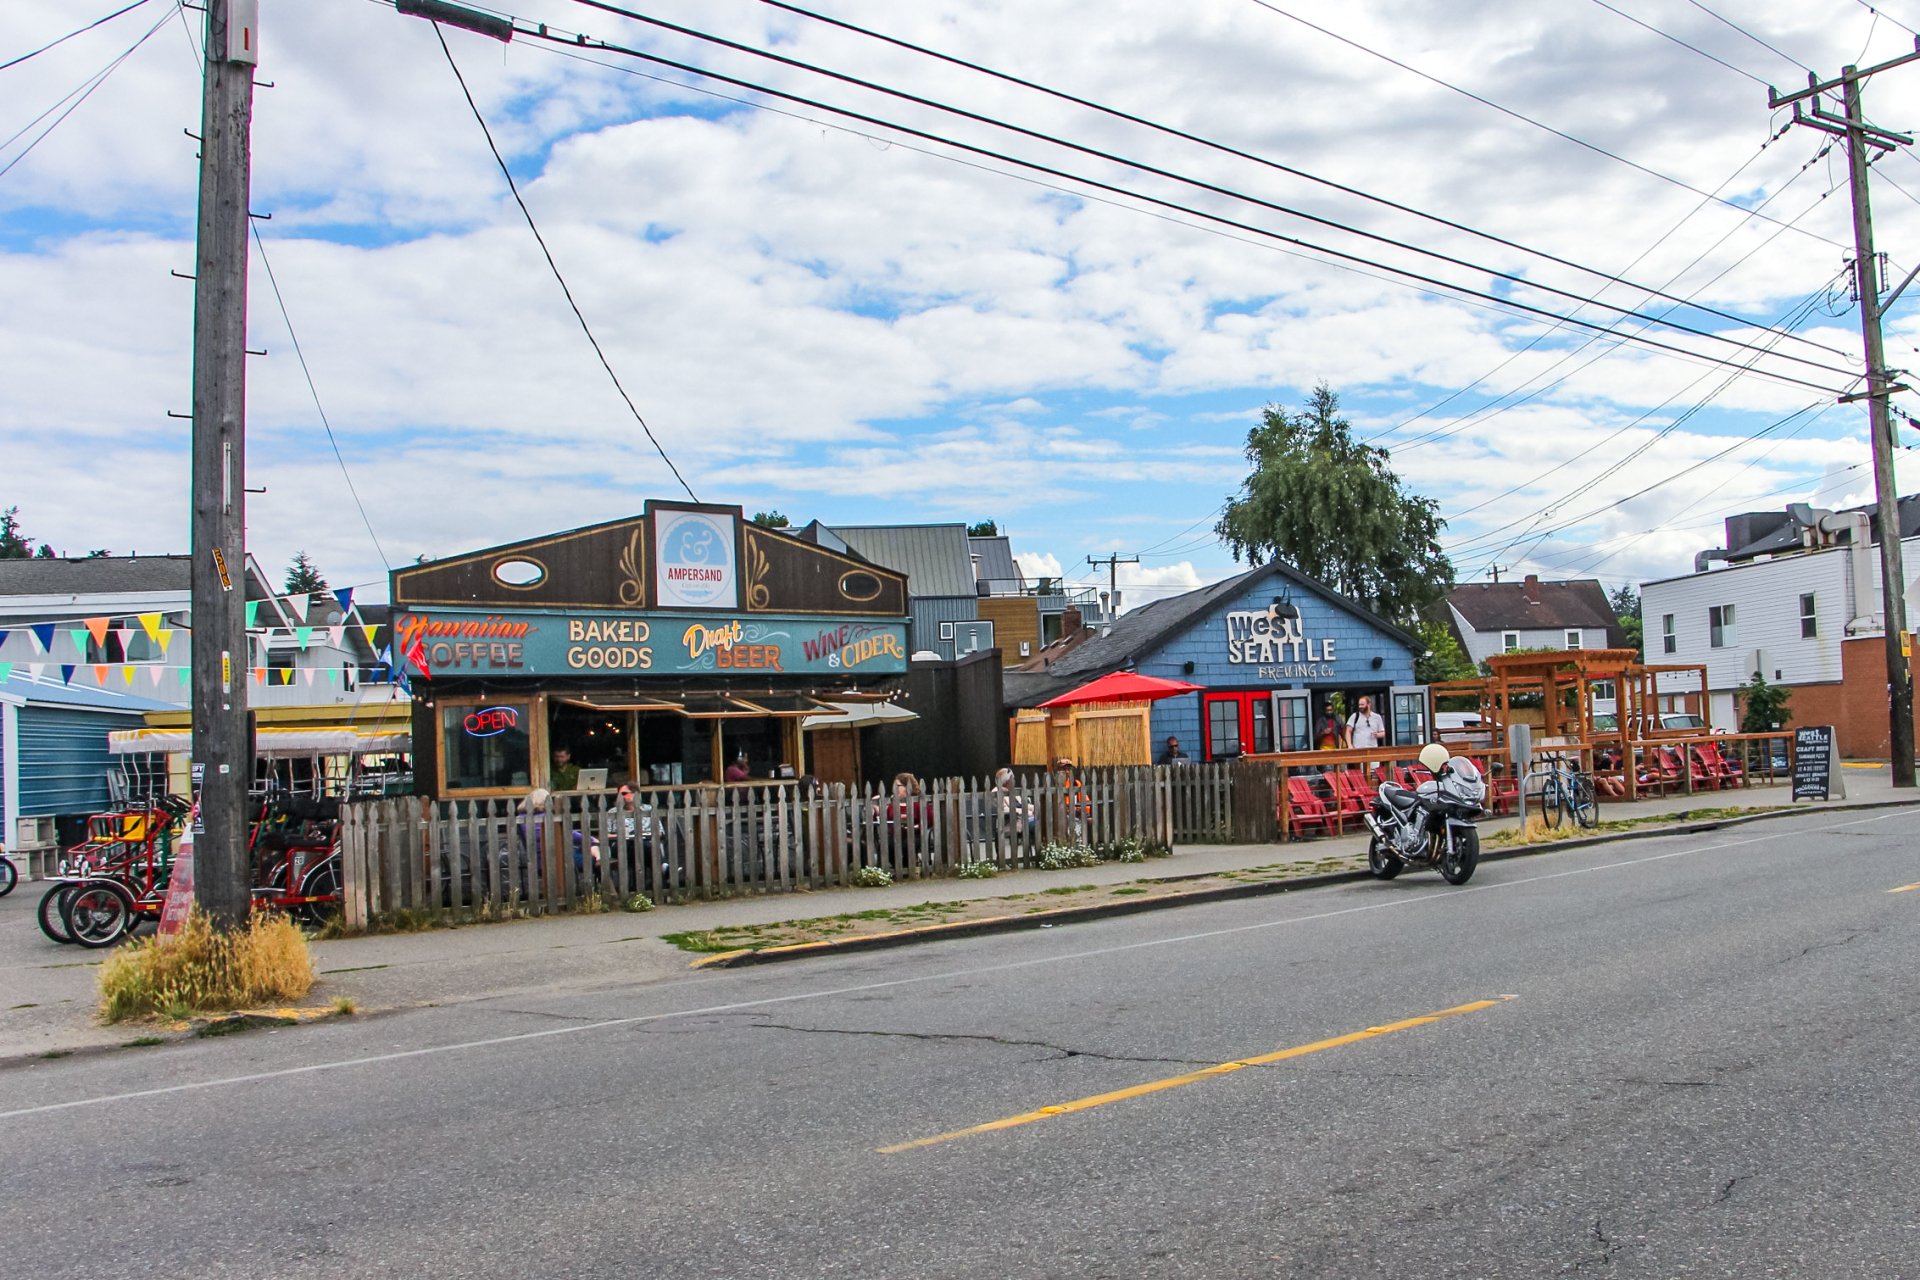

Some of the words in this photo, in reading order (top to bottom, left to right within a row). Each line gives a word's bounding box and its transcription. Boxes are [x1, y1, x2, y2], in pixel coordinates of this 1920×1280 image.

[668, 567, 722, 581] AMPERSAND
[395, 613, 538, 655] Hawaiian
[569, 620, 650, 642] BAKED
[682, 619, 744, 659] Draft
[803, 624, 850, 662] WINE
[567, 646, 653, 669] GOODS
[716, 644, 784, 672] BEER
[828, 653, 841, 668] &
[841, 634, 905, 668] CIDER
[1229, 638, 1337, 664] SEATTLE
[1258, 663, 1317, 682] BREWING
[463, 711, 516, 731] OPEN
